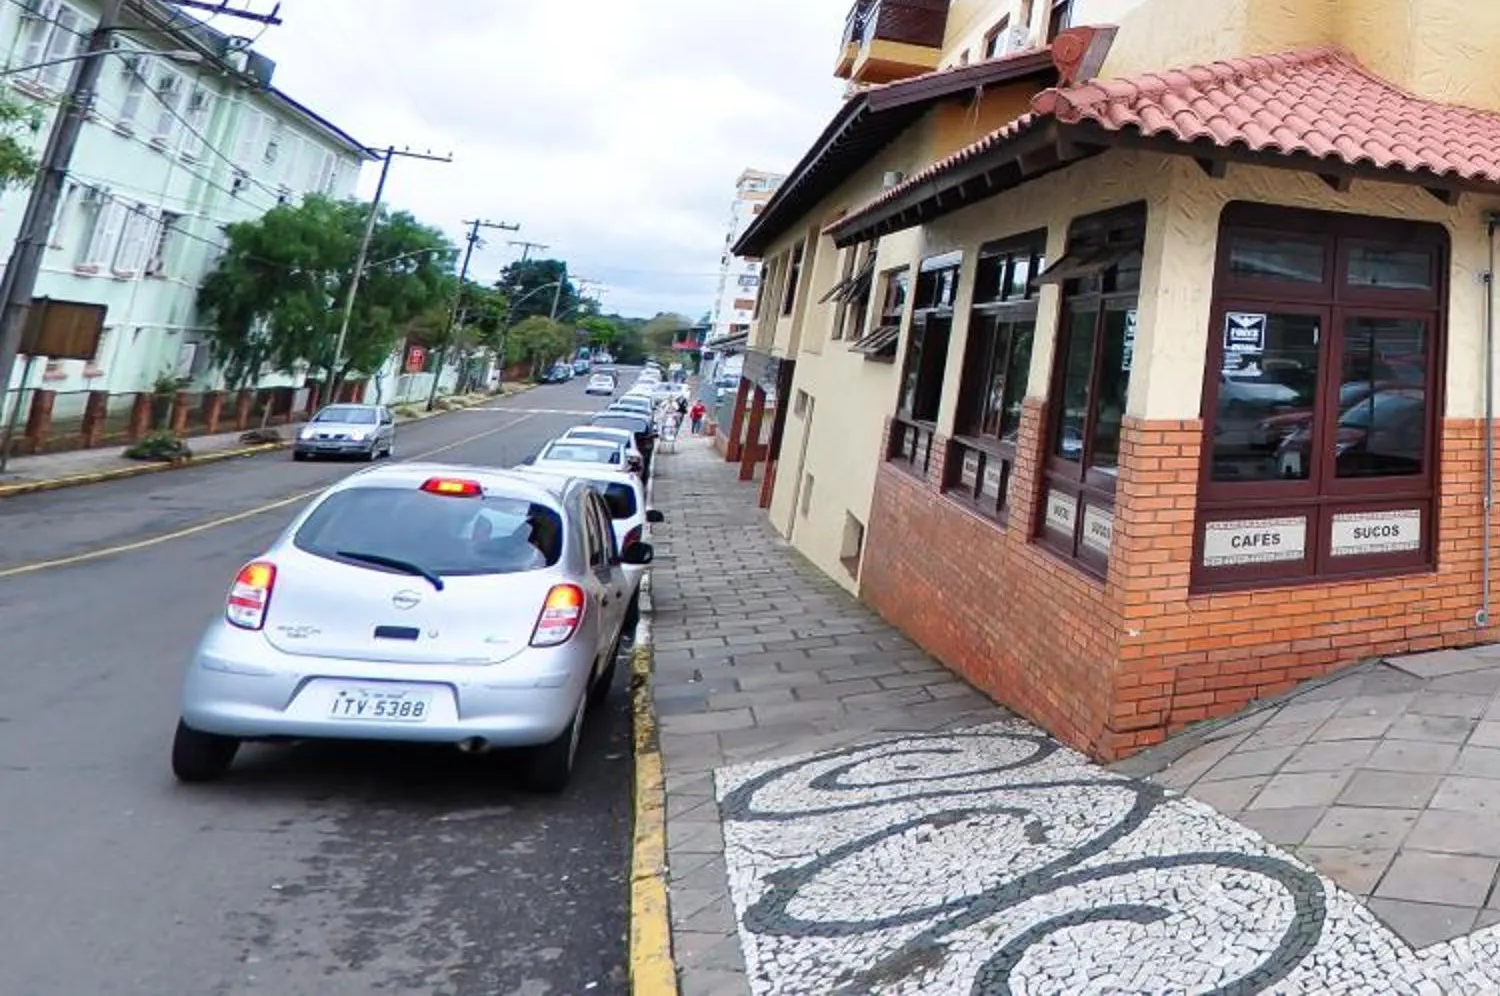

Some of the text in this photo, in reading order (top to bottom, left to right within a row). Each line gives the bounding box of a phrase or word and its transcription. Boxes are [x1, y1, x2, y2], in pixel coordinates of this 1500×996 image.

[1231, 530, 1281, 548] CAFÉS
[1353, 525, 1400, 539] SUCOS
[373, 700, 425, 717] 5388
